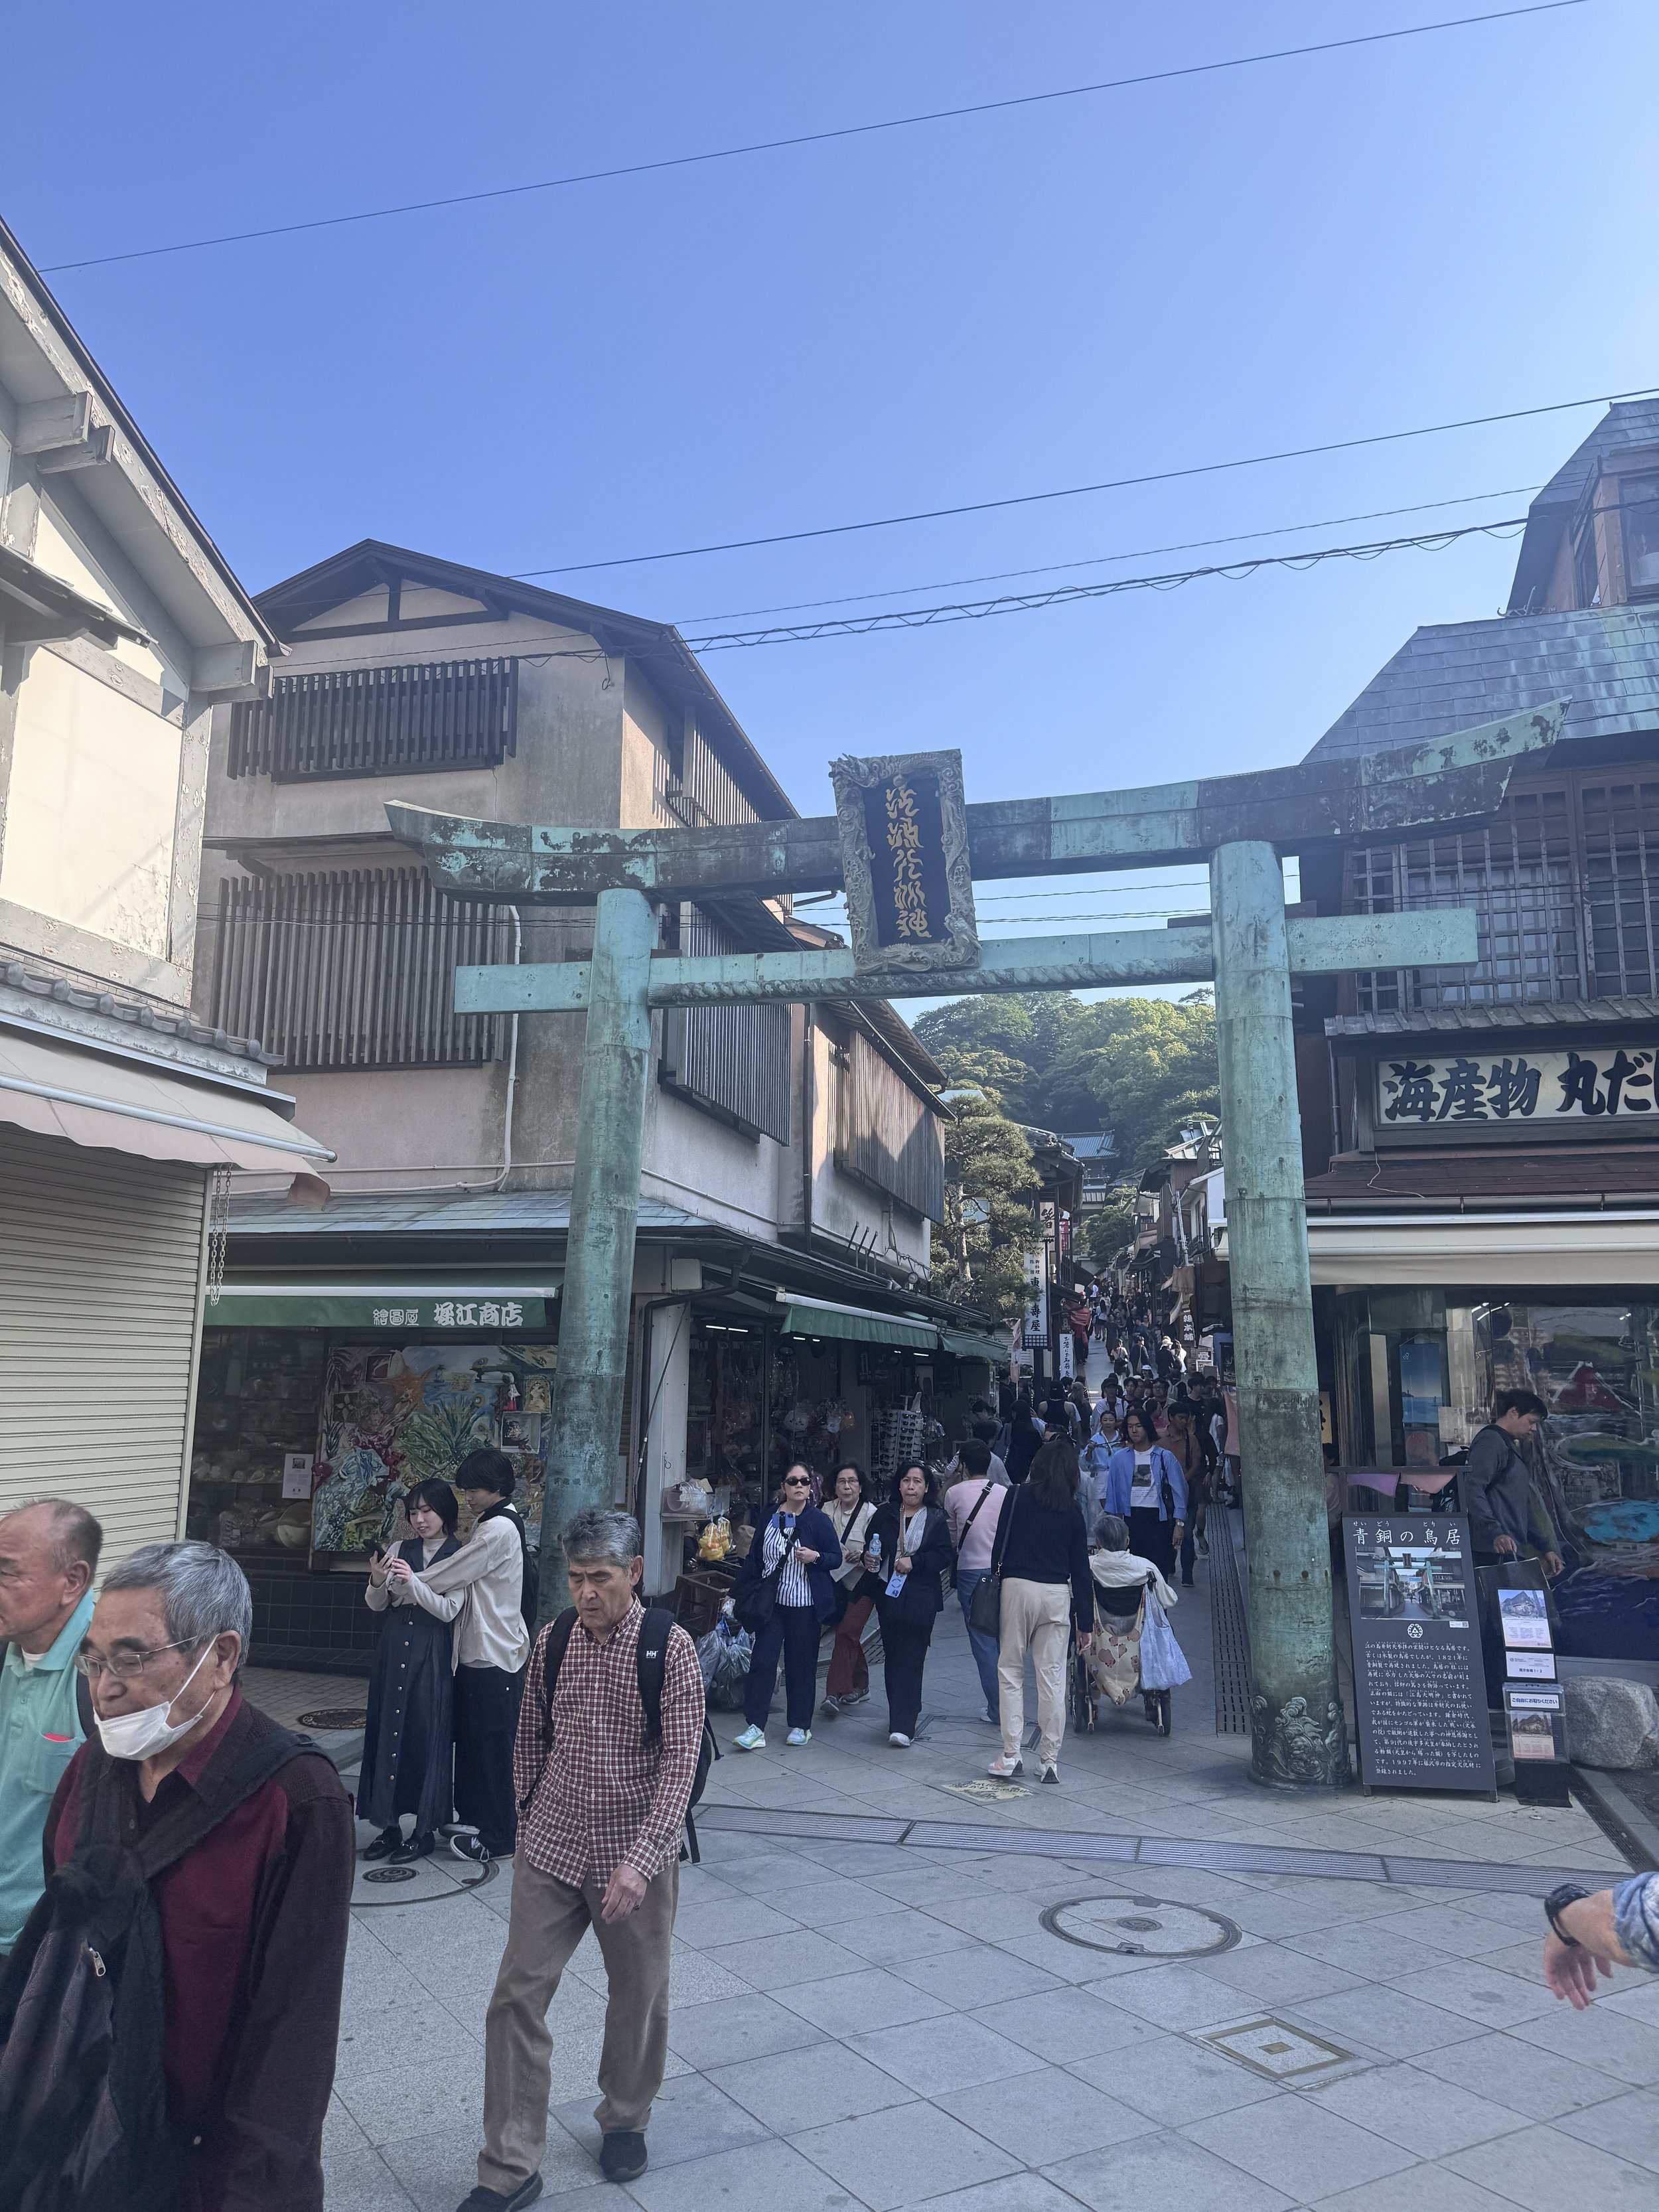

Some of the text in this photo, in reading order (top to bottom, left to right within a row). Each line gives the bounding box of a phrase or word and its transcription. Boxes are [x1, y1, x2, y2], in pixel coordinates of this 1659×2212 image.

[1382, 1049, 1659, 1122] 海産物 丸だ
[433, 1301, 524, 1327] 堀江商店
[1352, 1528, 1461, 1545] 青銅の鳥居
